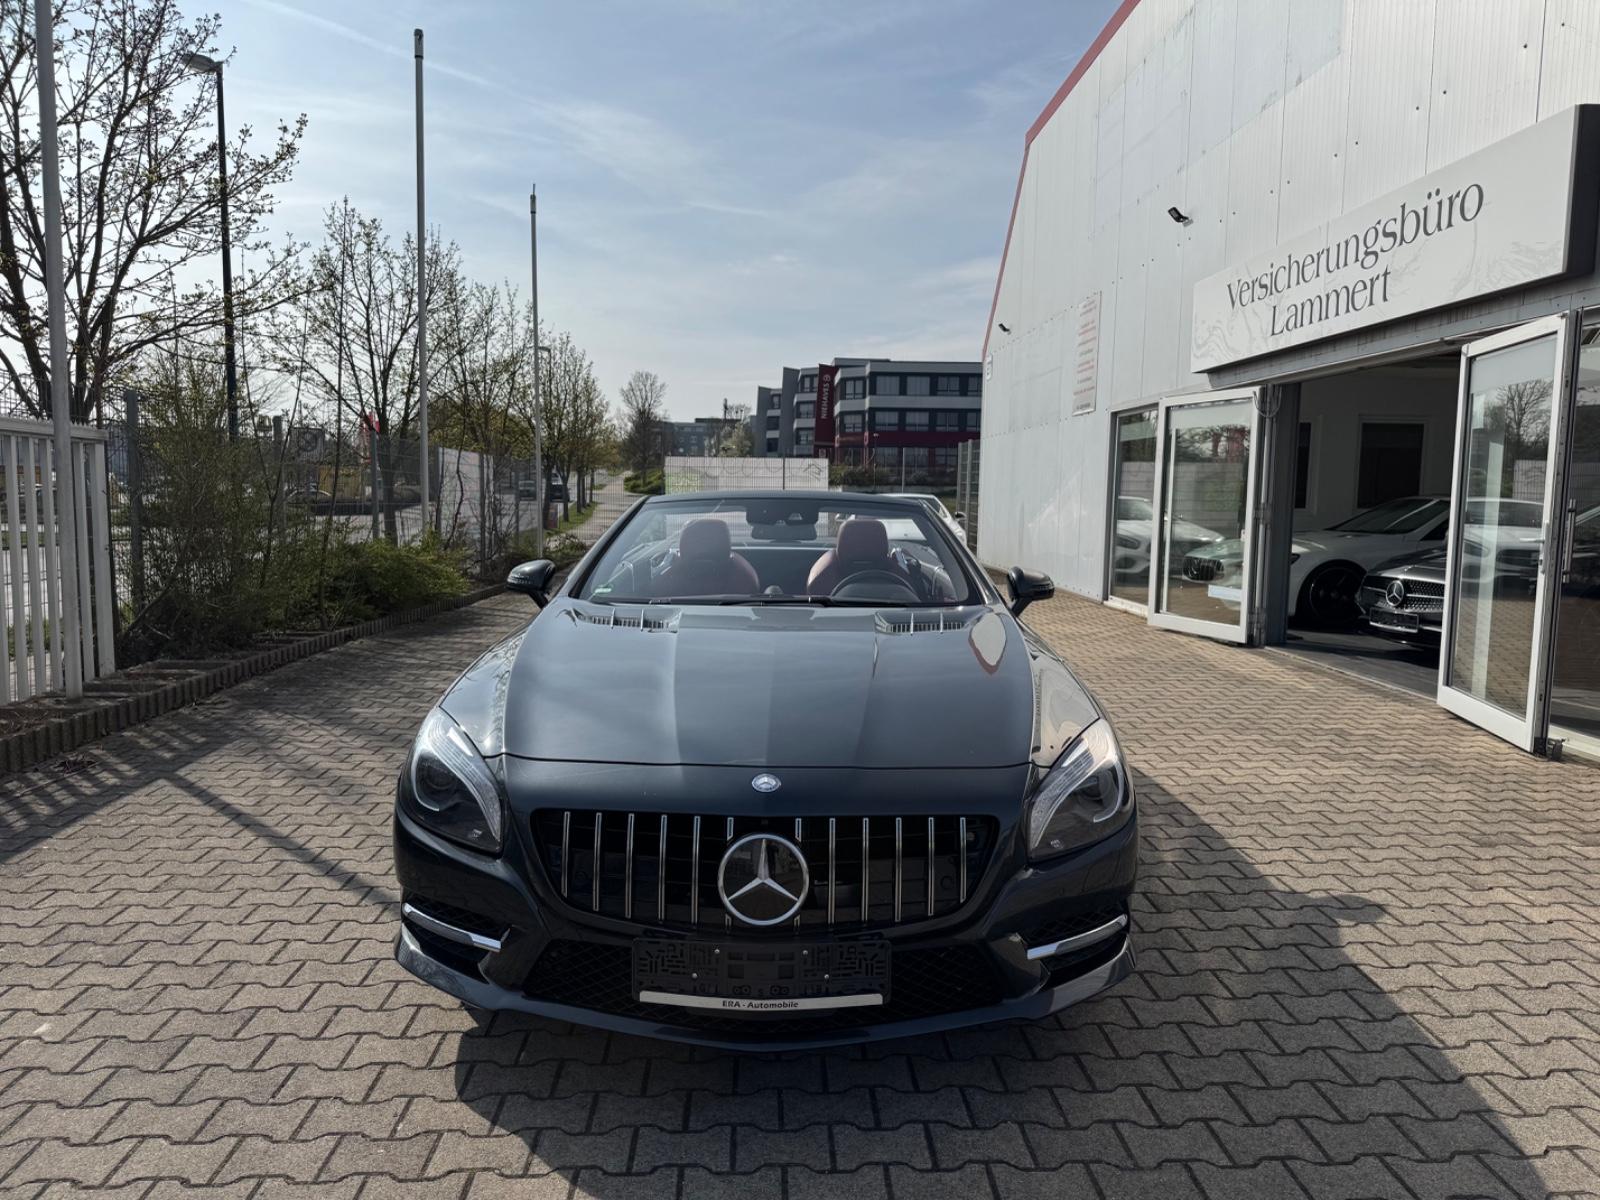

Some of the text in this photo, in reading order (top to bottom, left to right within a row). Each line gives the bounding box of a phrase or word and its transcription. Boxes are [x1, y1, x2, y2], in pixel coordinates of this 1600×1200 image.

[1226, 183, 1484, 310] Versicherungsbüro
[1270, 264, 1391, 337] Lammert
[722, 1000, 741, 1008] ERA
[747, 1001, 799, 1009] Automobile
